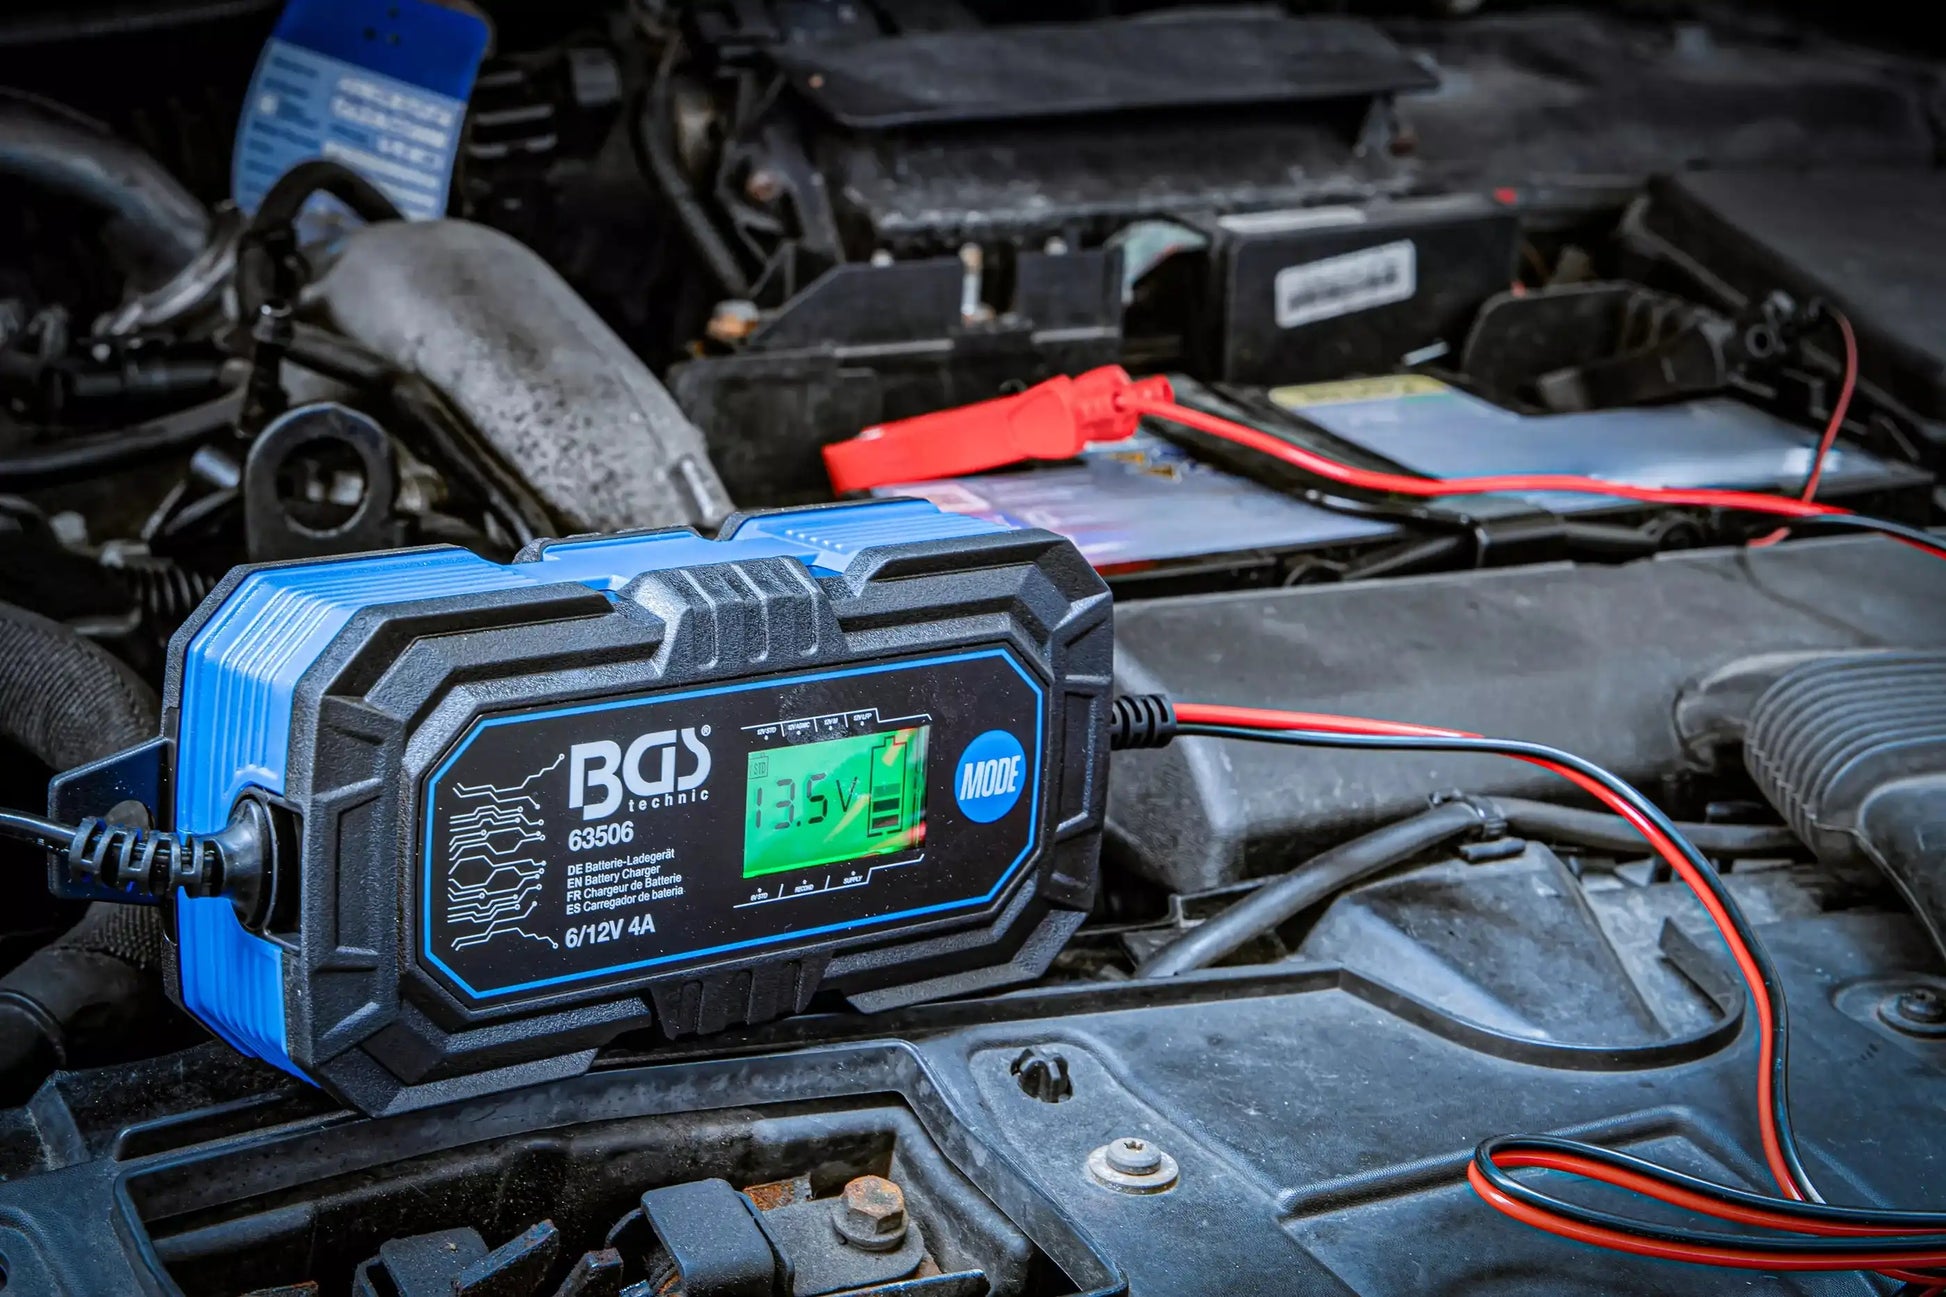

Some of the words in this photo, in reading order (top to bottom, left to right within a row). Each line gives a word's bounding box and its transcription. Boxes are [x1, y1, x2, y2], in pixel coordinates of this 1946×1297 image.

[960, 755, 1021, 801] MODE
[628, 788, 710, 813] technic
[568, 820, 635, 852] 63506
[566, 876, 583, 889] EN
[584, 872, 620, 886] Battery
[621, 864, 661, 880] Charger
[567, 863, 584, 876] DE
[584, 848, 676, 874] Batterie-Ladegerät
[565, 902, 581, 916] ES
[582, 894, 637, 912] Carregador
[637, 891, 651, 903] de
[651, 885, 685, 900] bateria
[566, 889, 582, 902] FR
[583, 883, 629, 899] Chargeur
[630, 879, 643, 891] de
[644, 872, 683, 888] Batterie
[564, 918, 625, 949] 6/12V
[627, 913, 656, 936] 4A
